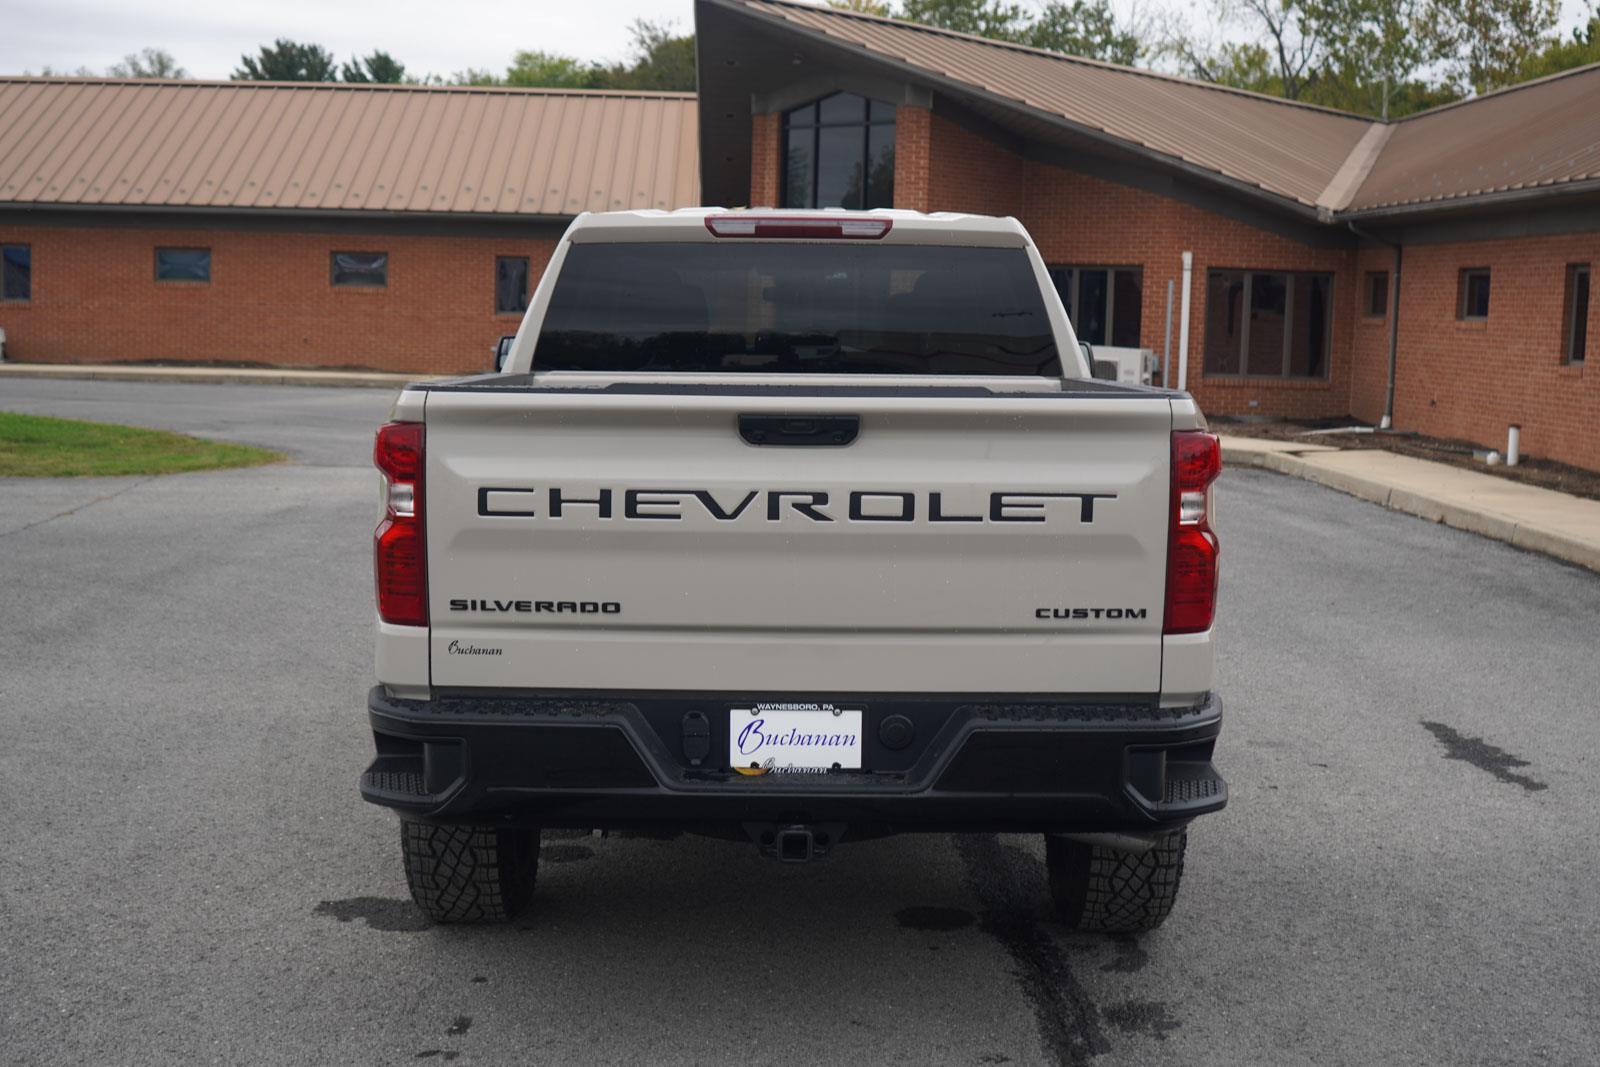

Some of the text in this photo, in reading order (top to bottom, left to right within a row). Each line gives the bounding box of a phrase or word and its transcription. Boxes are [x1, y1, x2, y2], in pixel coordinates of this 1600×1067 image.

[477, 487, 1118, 523] CHEVROLET
[450, 599, 621, 614] SILVERADO
[1035, 608, 1147, 619] CUSTOM
[448, 640, 503, 656] Buchanan
[757, 703, 820, 711] WAYNESBORO,
[738, 719, 856, 755] Buchanan
